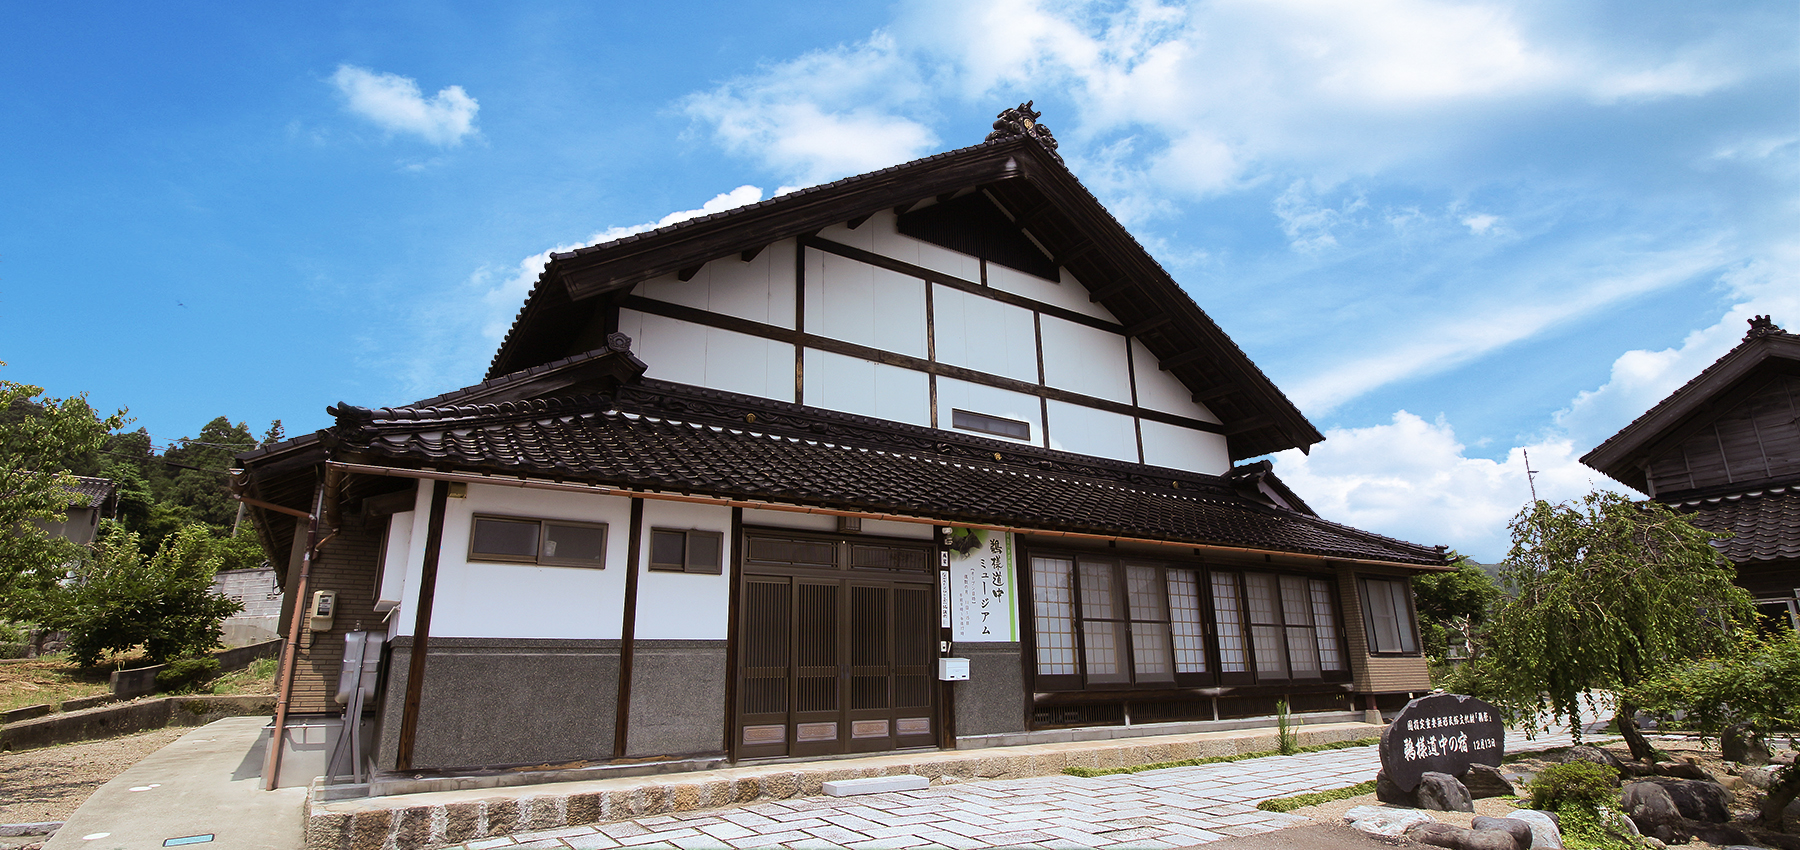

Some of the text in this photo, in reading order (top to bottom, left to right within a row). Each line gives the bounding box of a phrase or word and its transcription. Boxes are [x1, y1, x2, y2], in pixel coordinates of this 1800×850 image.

[980, 559, 990, 635] ミュージアム
[1473, 738, 1497, 751] 12月13日
